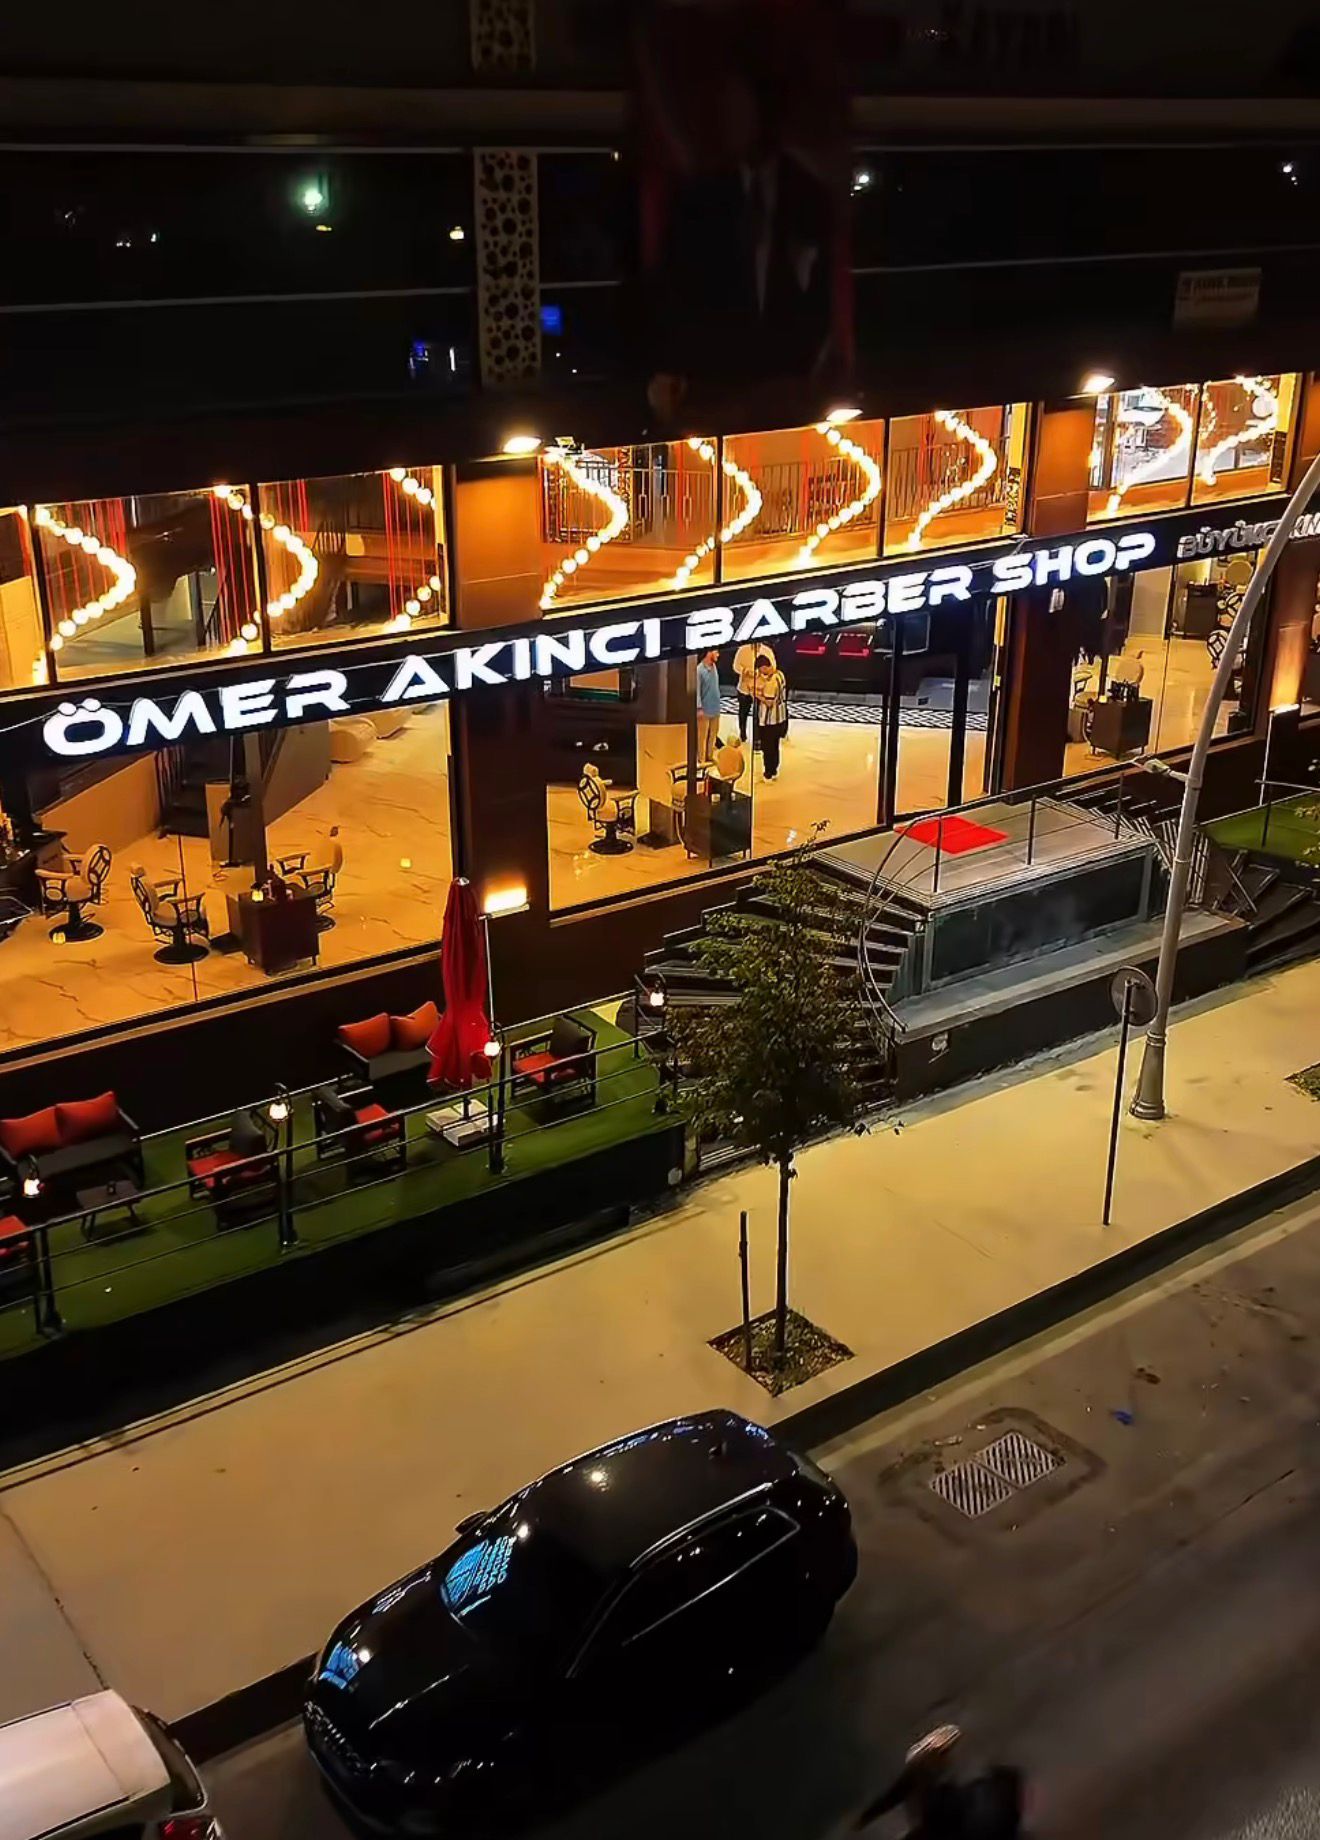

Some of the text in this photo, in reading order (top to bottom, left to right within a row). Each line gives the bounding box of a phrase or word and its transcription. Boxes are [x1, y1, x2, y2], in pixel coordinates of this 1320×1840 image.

[43, 532, 1156, 756] ÖMER AKINCI BARBER SHOP
